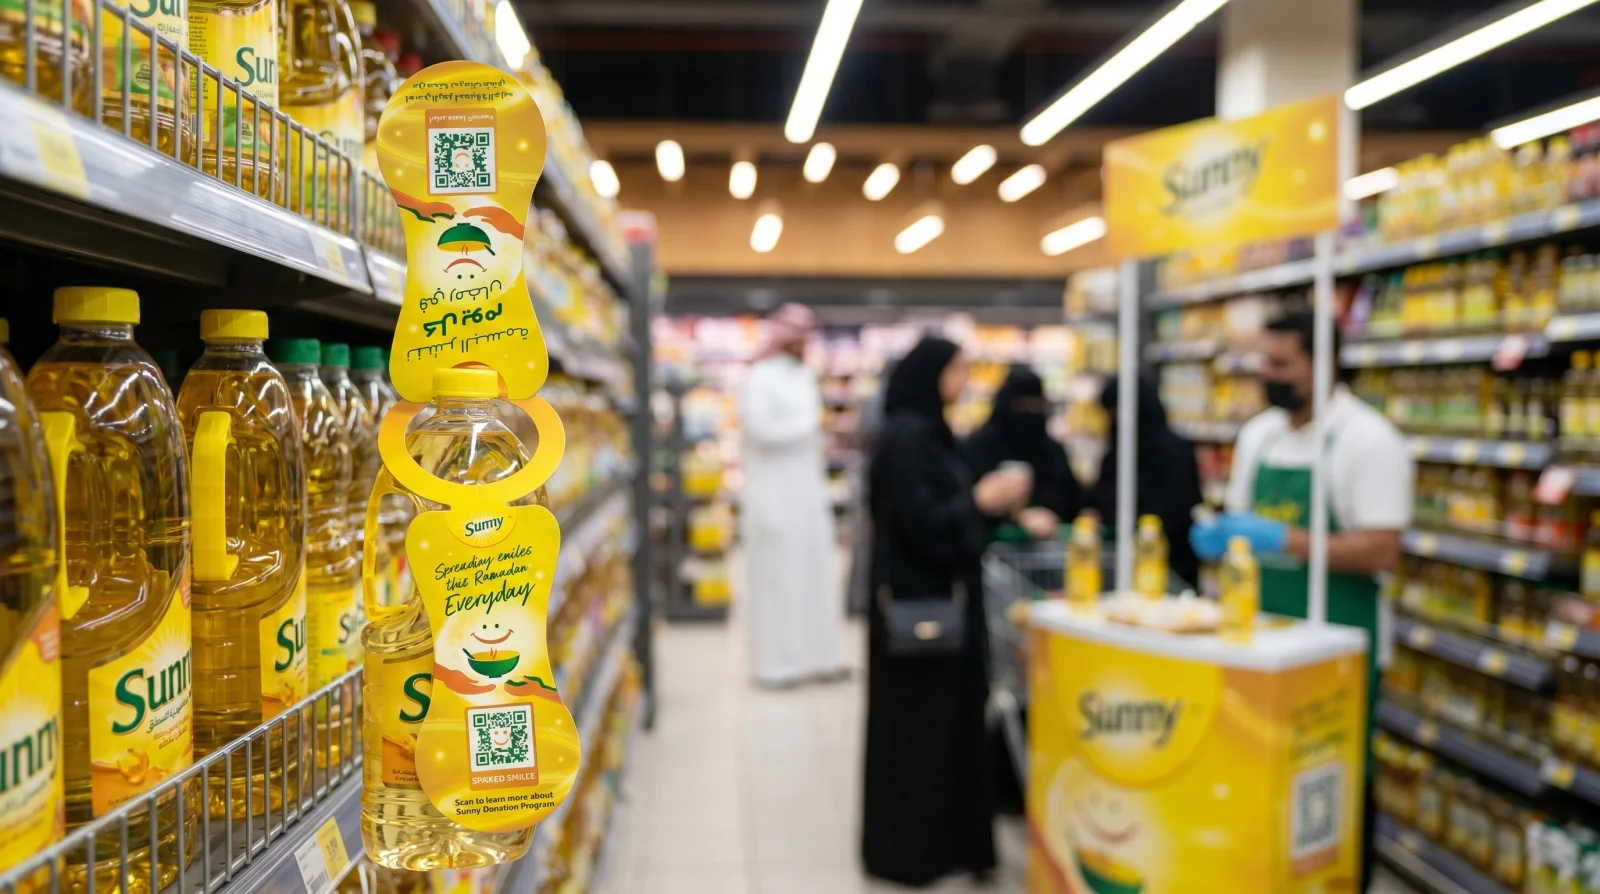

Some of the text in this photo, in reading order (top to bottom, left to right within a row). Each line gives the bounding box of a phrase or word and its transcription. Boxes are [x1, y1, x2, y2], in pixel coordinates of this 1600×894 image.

[1161, 137, 1271, 217] Sunny
[419, 287, 445, 313] في
[423, 302, 503, 338] كل يوم
[461, 327, 529, 353] البسمة
[465, 516, 504, 537] Sunny
[474, 562, 528, 587] Ramadan
[445, 579, 536, 616] Everyday
[275, 614, 306, 673] Su
[112, 648, 192, 734] Sunn
[1077, 690, 1185, 750] Sunny
[454, 791, 554, 806] Scan to learn more about
[456, 801, 555, 816] Sunny Donation Program
